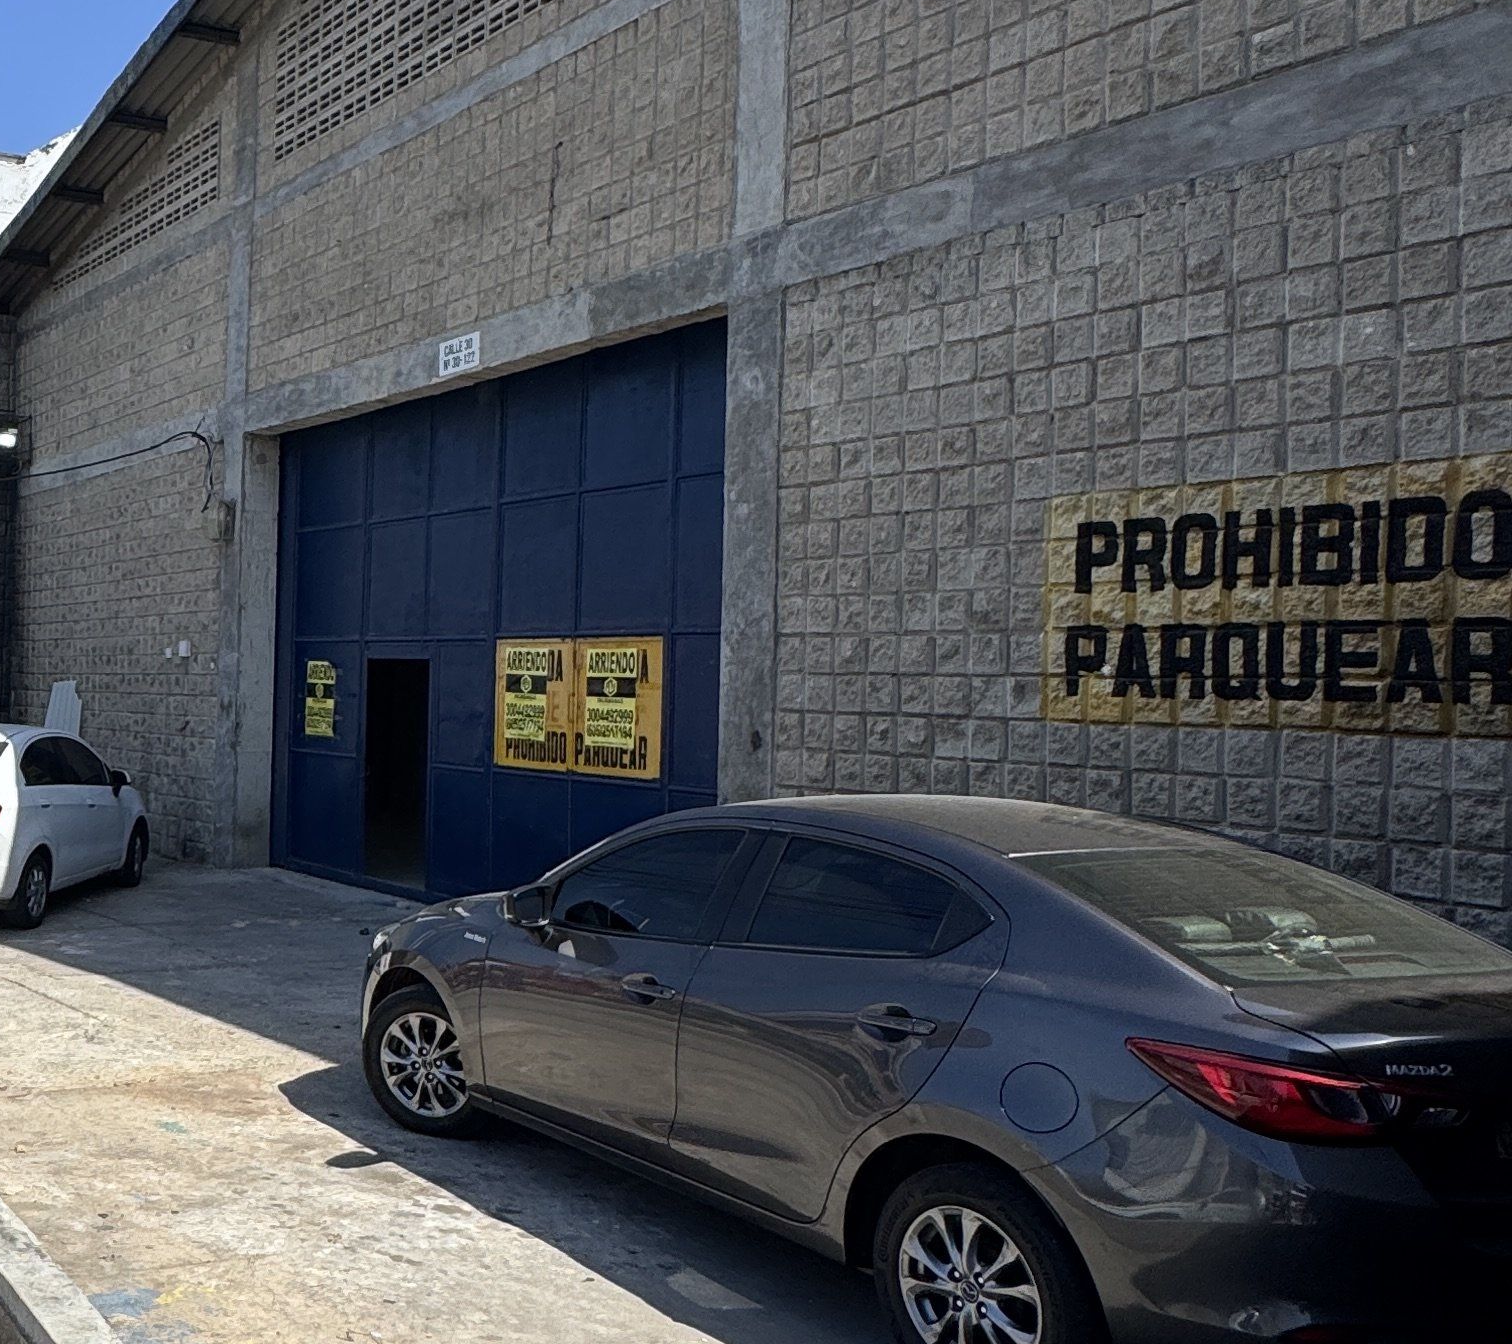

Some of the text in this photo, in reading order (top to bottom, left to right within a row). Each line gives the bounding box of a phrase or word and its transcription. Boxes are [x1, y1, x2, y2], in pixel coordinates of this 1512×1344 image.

[1074, 488, 1512, 594] PROHIBIDO
[507, 651, 547, 672] ARRIENDO
[588, 652, 636, 674] ARRIENDO
[1065, 616, 1512, 705] PARQUEAR
